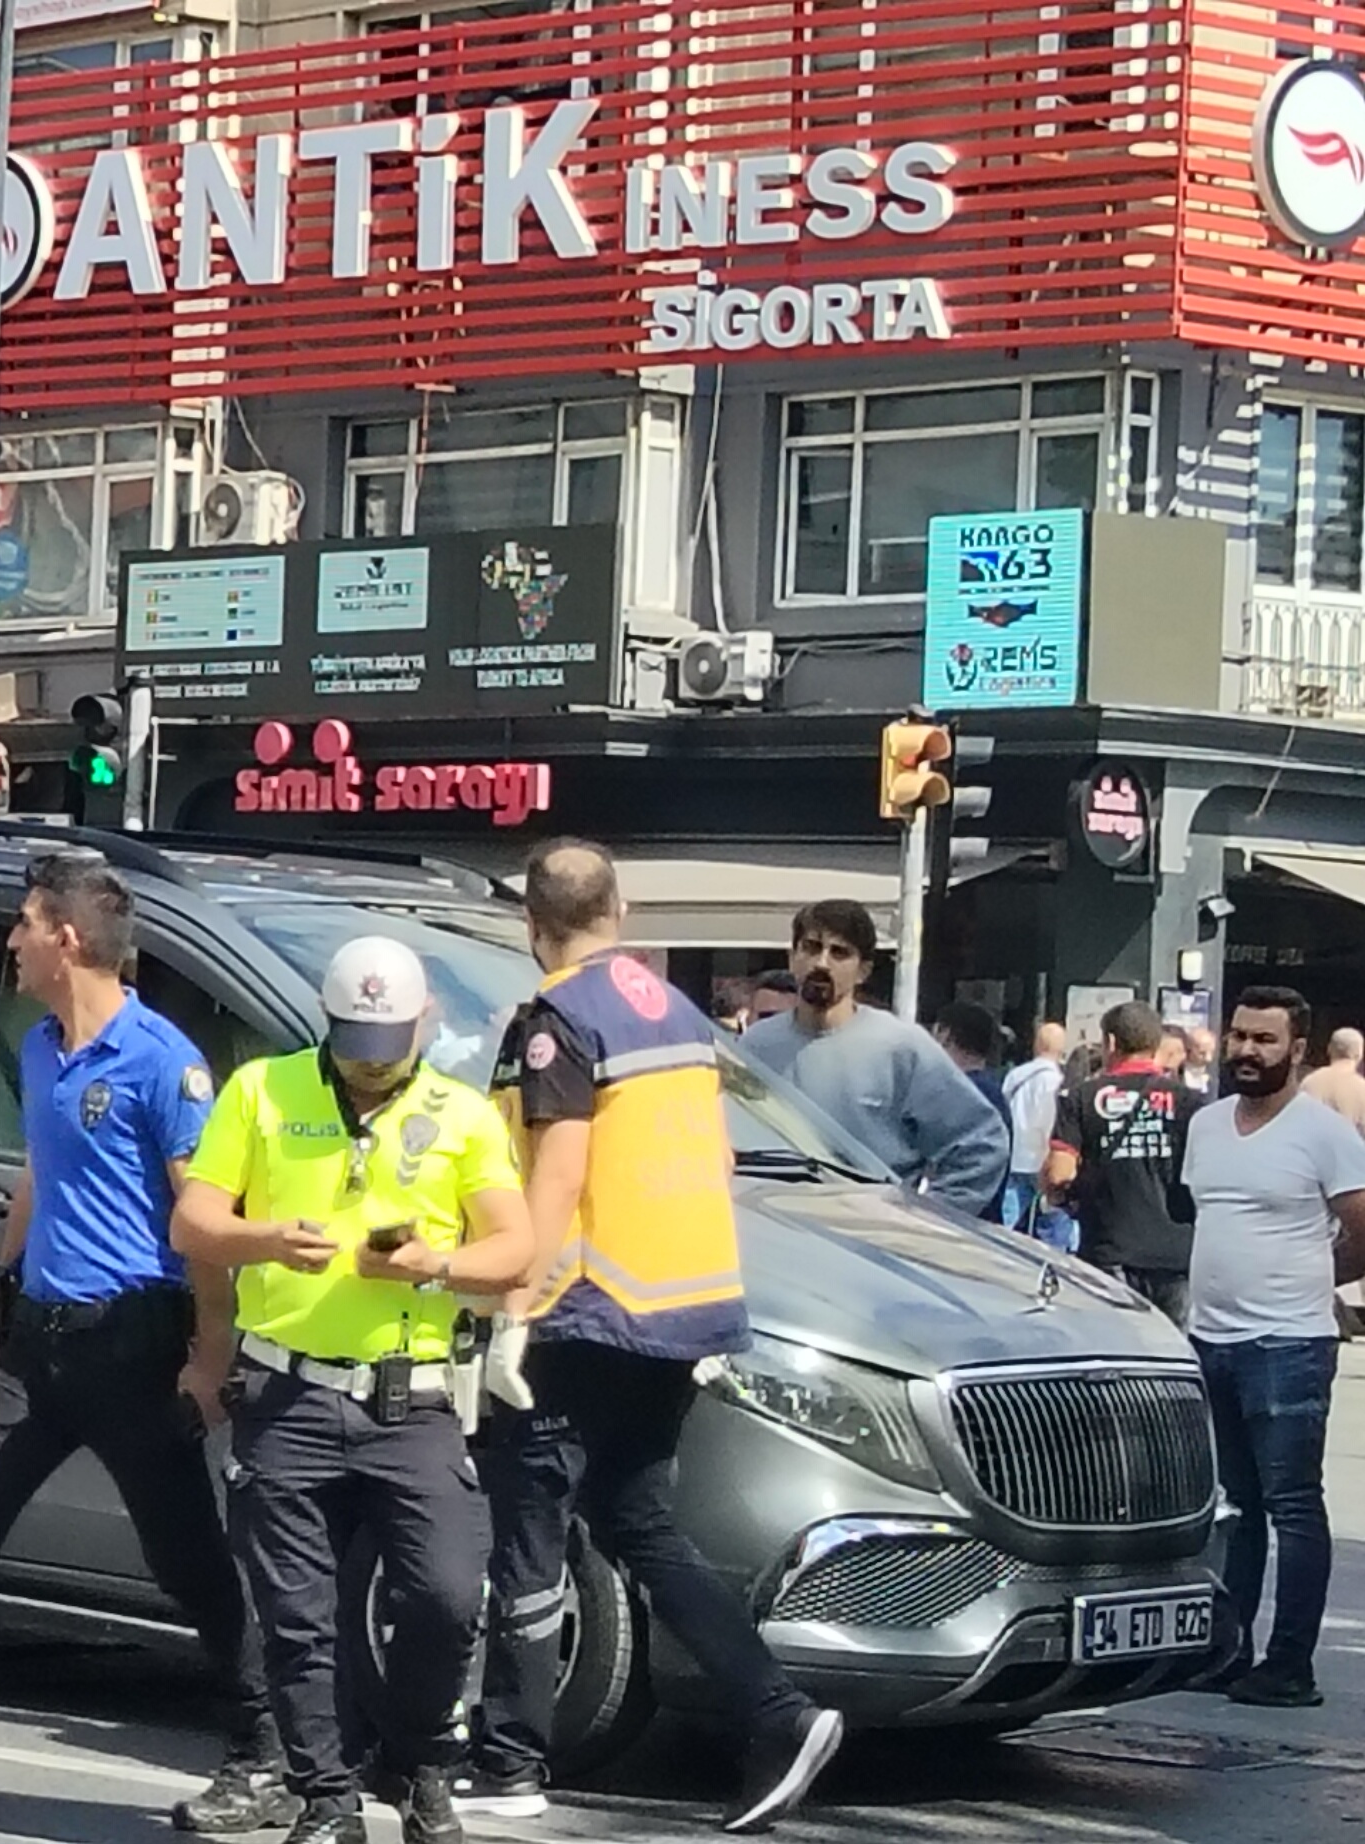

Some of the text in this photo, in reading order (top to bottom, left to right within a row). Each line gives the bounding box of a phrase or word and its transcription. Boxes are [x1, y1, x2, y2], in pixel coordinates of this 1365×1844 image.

[624, 141, 958, 254] INESS
[959, 524, 1054, 548] KARGO
[1001, 547, 1053, 580] 63
[234, 719, 364, 812] simit
[1095, 1609, 1118, 1651] 34
